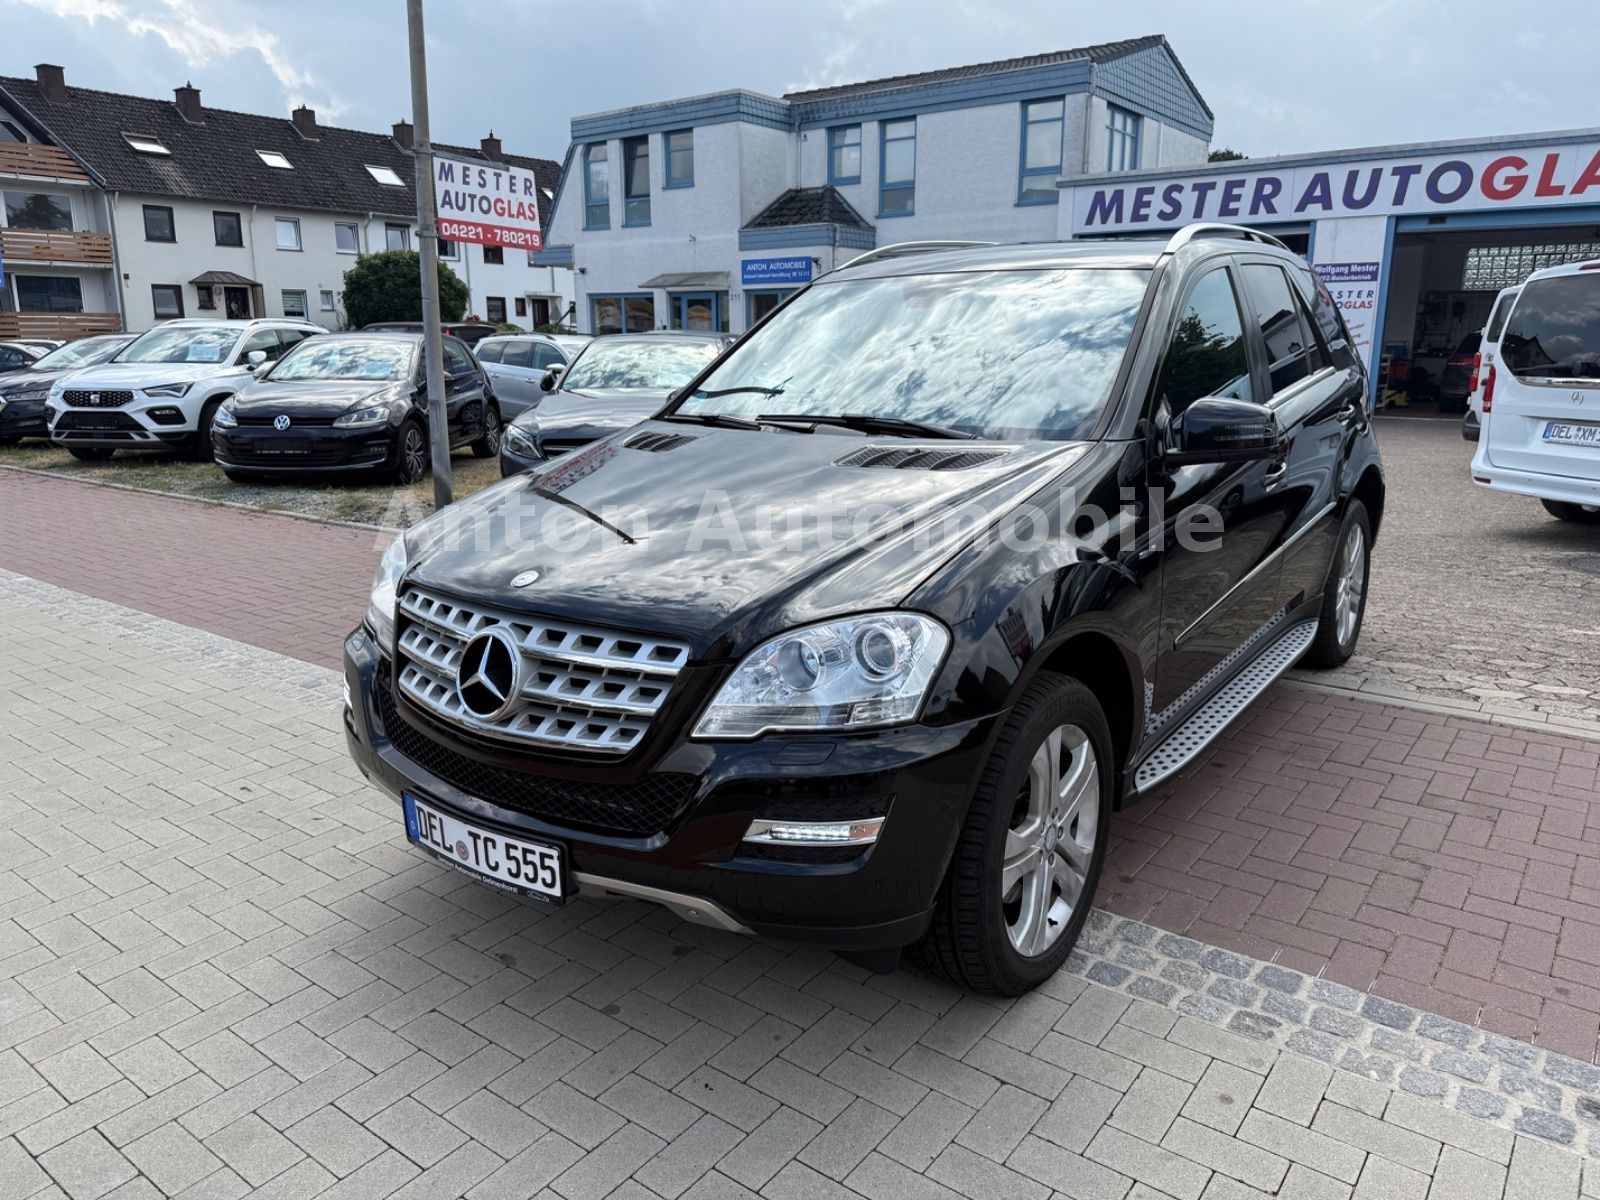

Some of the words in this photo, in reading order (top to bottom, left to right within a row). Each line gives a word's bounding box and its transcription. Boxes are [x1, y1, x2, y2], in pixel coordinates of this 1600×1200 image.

[438, 162, 533, 196] MESTER
[440, 189, 536, 221] AUTOGLAS
[1085, 177, 1283, 225] MESTER
[441, 222, 484, 240] 04221
[493, 229, 540, 247] 780219
[770, 261, 806, 270] AUTOMOBILE
[1350, 264, 1377, 272] Mester
[1550, 425, 1572, 439] DEL
[416, 806, 454, 853] DEL
[467, 830, 500, 872] TC
[505, 842, 557, 889] 555
